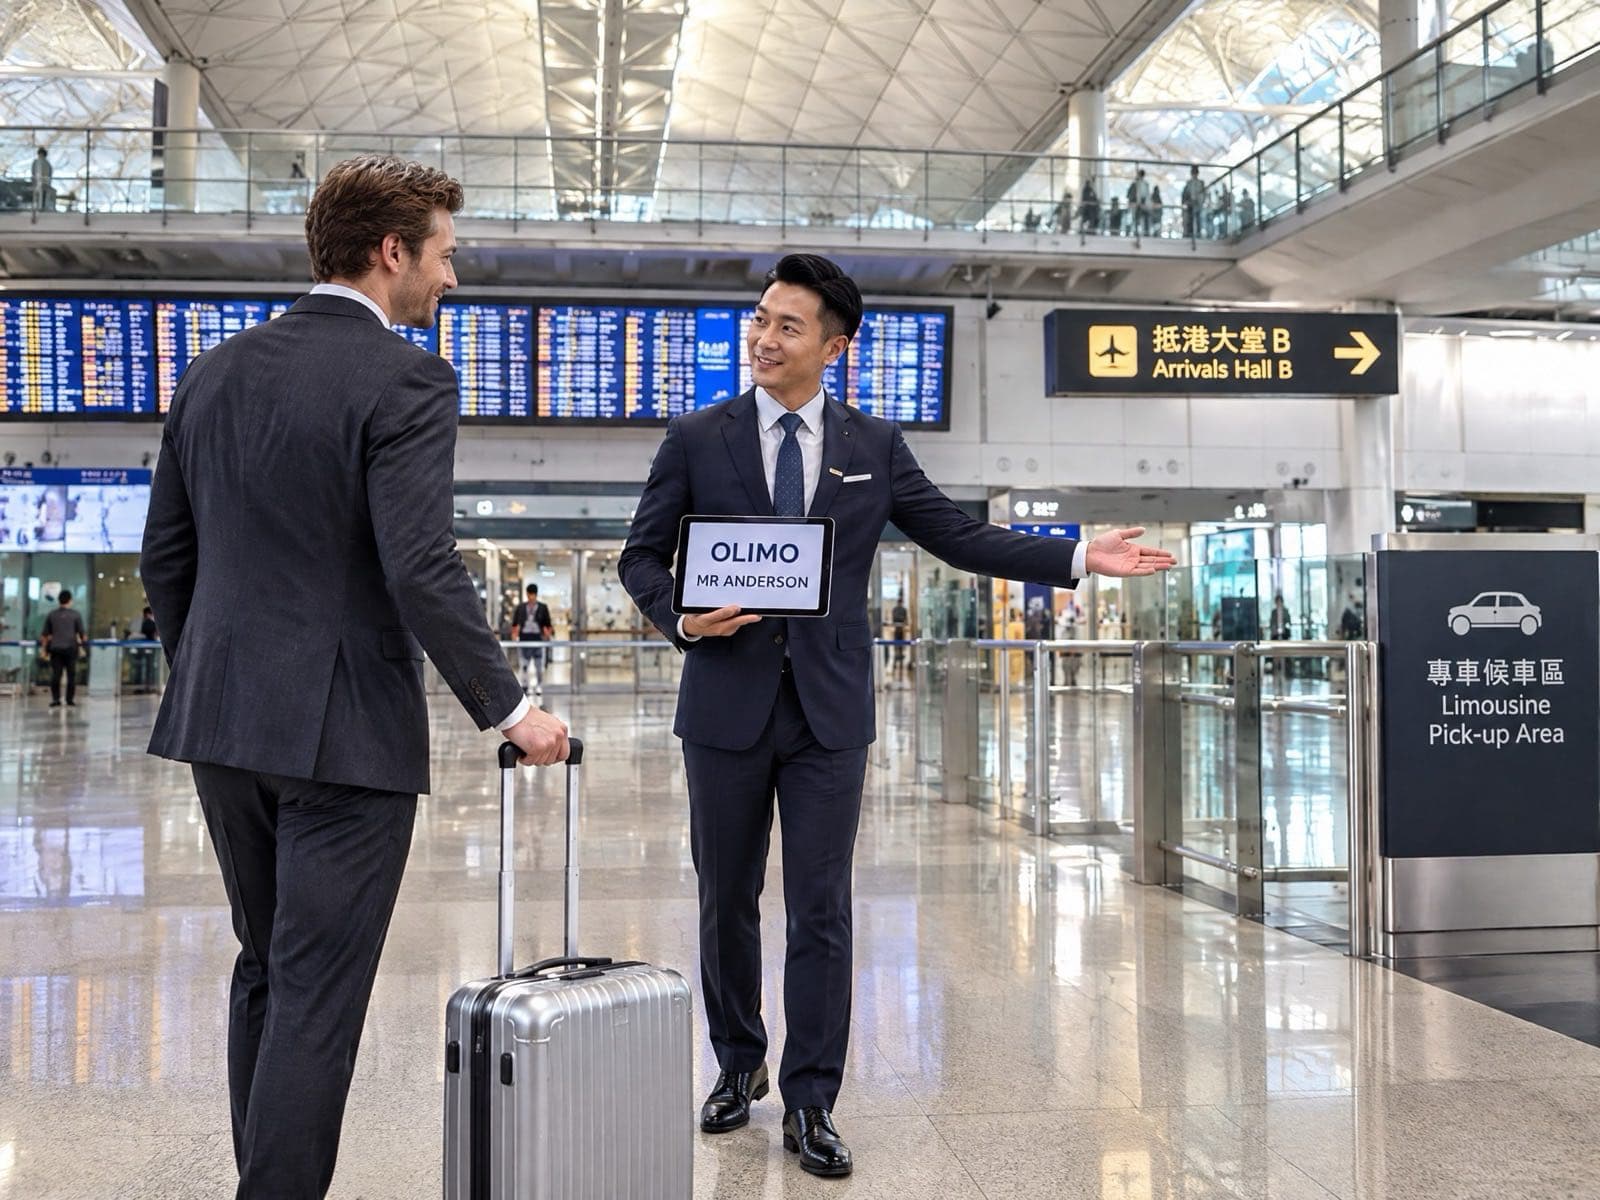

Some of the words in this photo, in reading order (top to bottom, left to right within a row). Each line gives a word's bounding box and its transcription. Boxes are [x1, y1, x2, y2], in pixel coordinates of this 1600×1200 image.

[1272, 327, 1292, 354] B
[1152, 358, 1229, 379] Arrivals
[1234, 358, 1273, 379] Hall
[1278, 359, 1293, 379] B
[710, 541, 800, 564] OLIMO
[696, 574, 719, 587] MR
[723, 575, 809, 589] ANDERSON
[1426, 658, 1565, 687] 專車候車區
[1442, 694, 1551, 716] Limousine
[1429, 723, 1510, 749] Pick-up
[1515, 722, 1565, 744] Area
